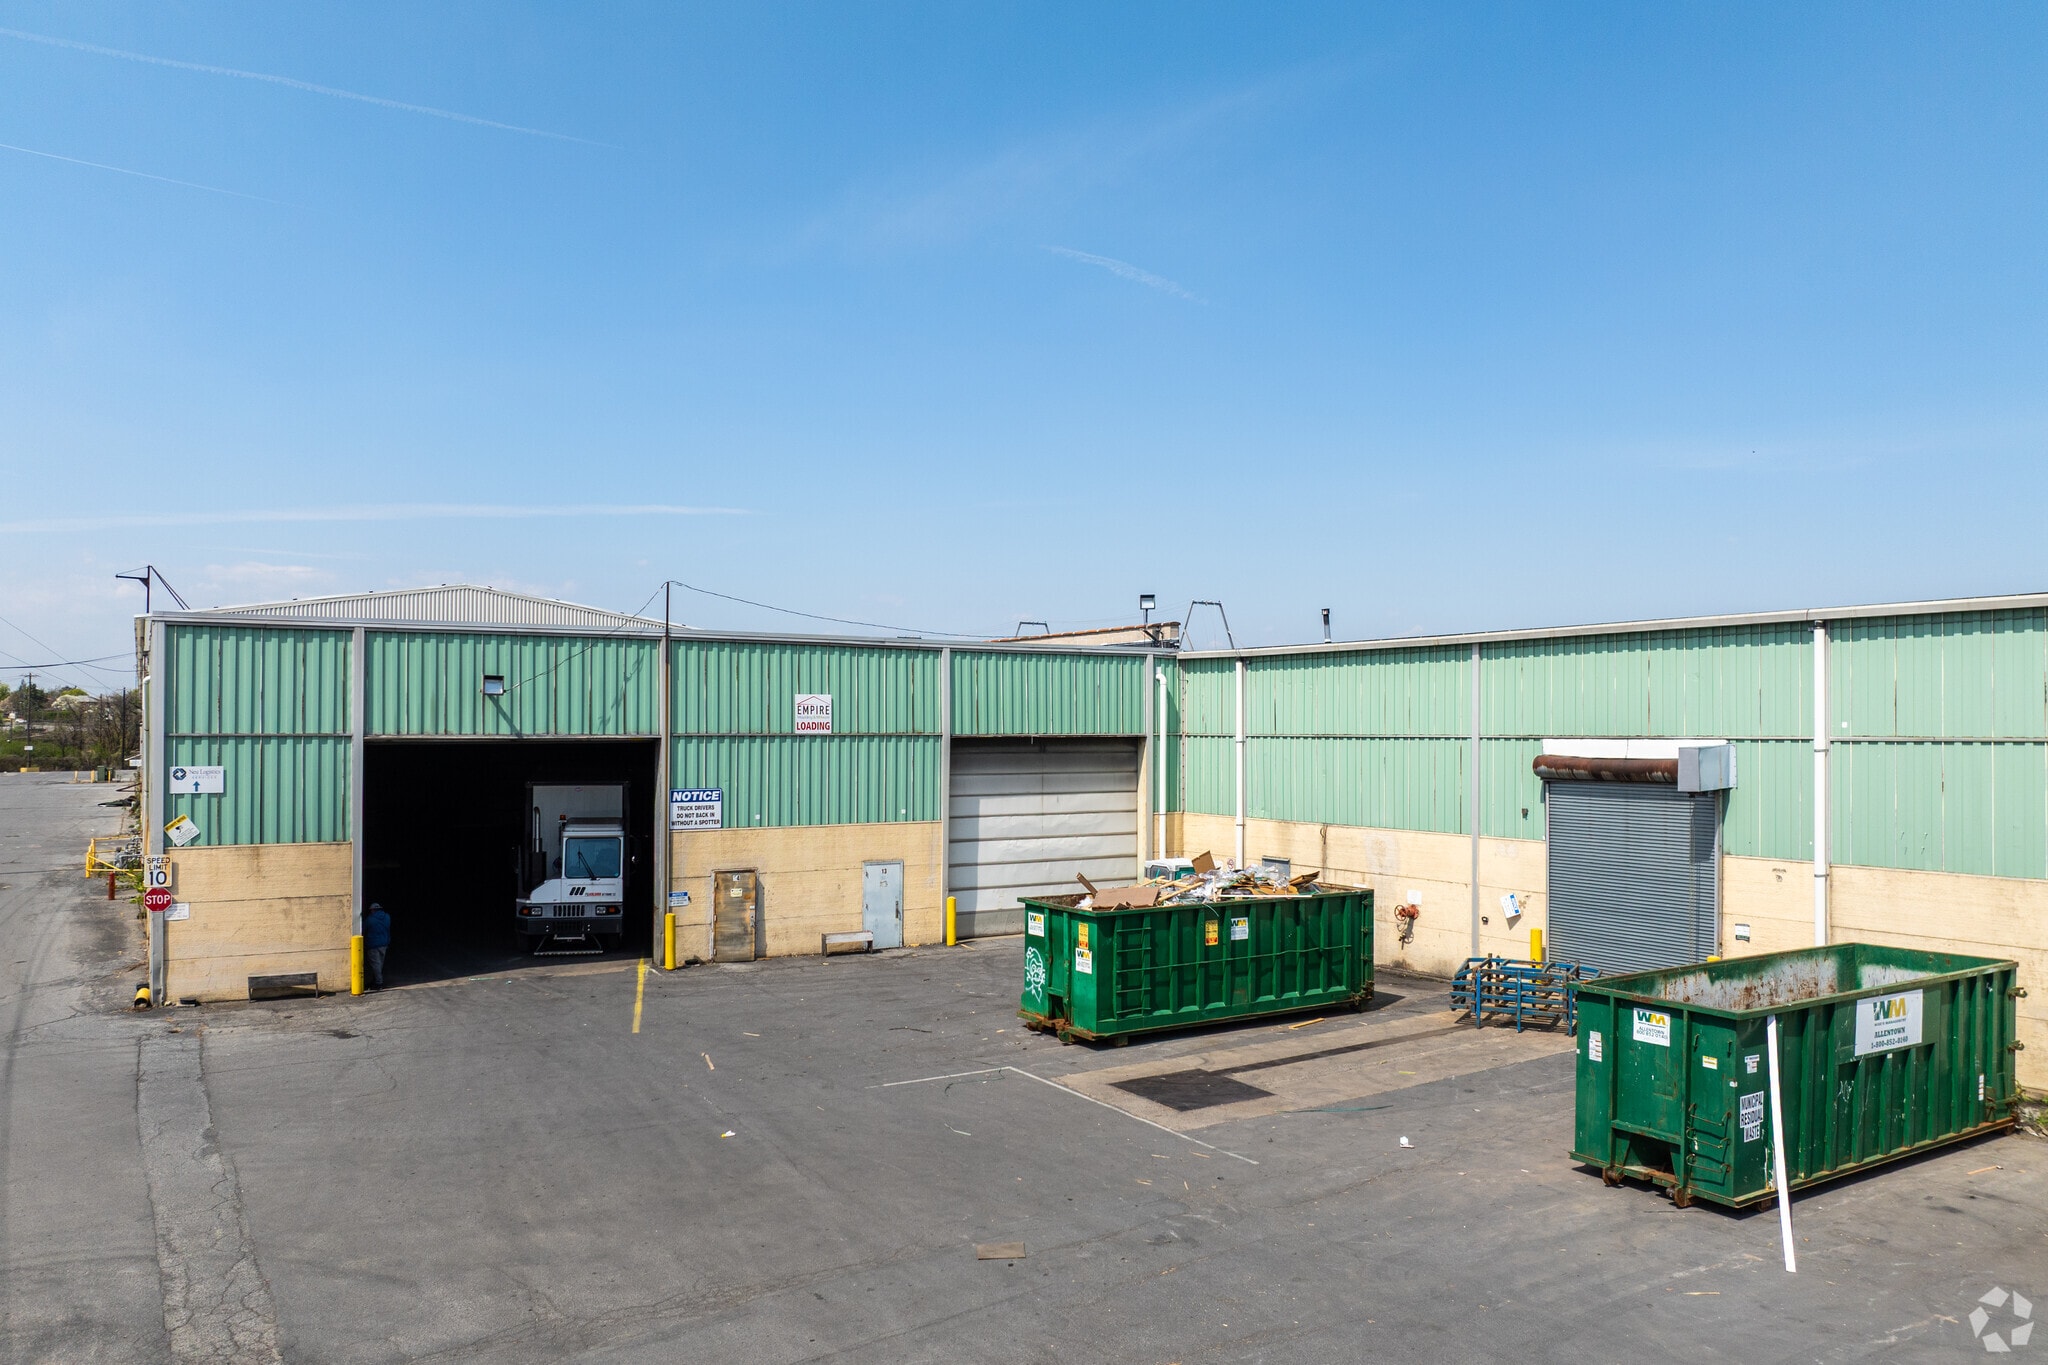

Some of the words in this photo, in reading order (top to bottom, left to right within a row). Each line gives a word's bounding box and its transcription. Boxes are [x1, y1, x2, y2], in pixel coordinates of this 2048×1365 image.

[797, 705, 830, 715] EMPIRE
[796, 721, 831, 731] LOADING
[672, 791, 720, 802] NOTICE
[149, 871, 167, 886] 10
[145, 894, 171, 905] STOP
[1873, 997, 1906, 1021] WM
[1636, 1010, 1666, 1025] WM
[1639, 1026, 1665, 1035] ALLENTOWN
[1874, 1026, 1906, 1038] ALLENTOWN
[1741, 1108, 1763, 1127] RESIDUAL
[1745, 1124, 1760, 1141] WASTE
